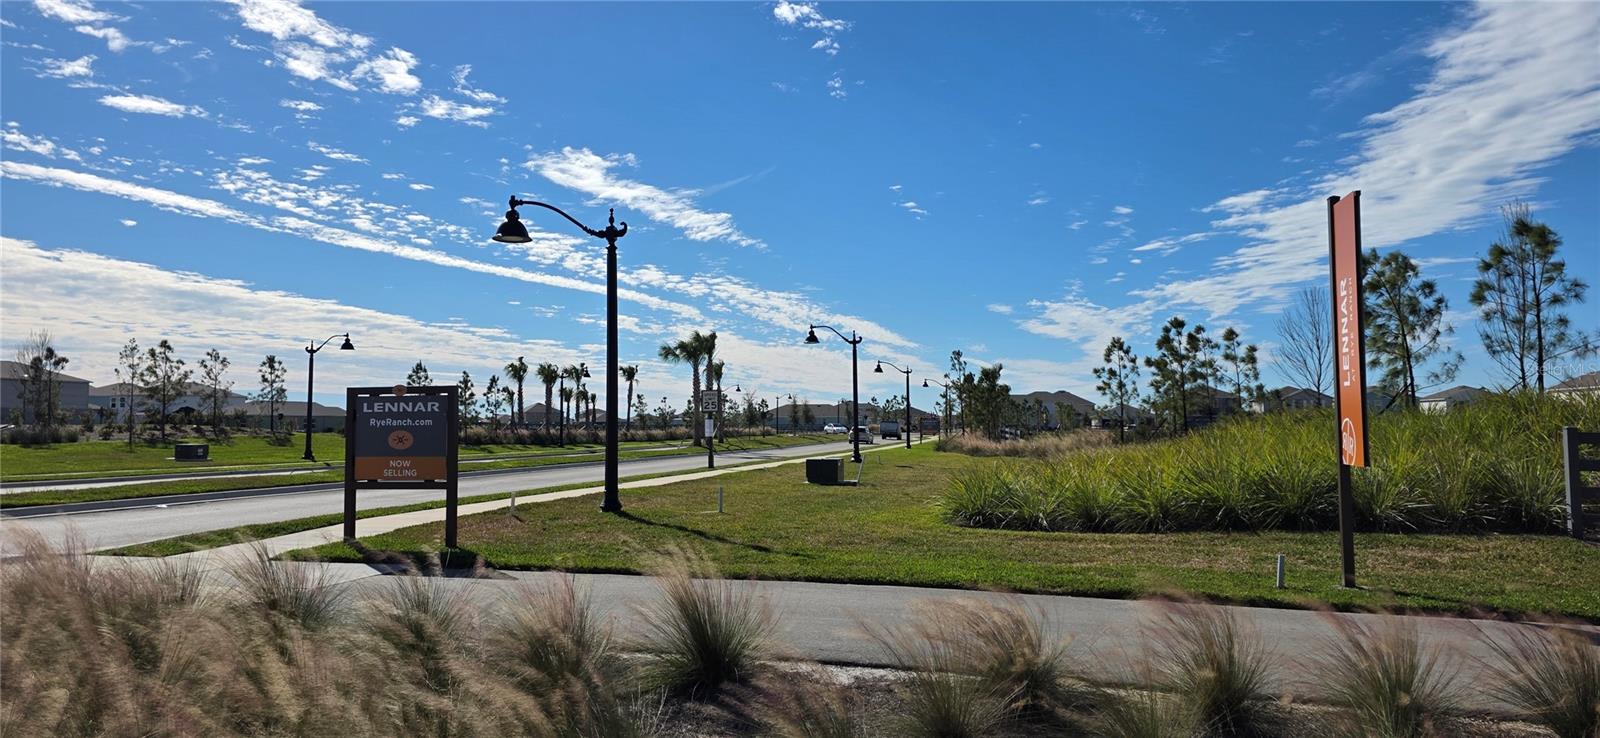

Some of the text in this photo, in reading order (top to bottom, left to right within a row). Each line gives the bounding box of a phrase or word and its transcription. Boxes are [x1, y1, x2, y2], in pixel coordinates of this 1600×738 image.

[1340, 278, 1350, 386] LENNAR
[363, 402, 440, 412] LENNAR
[704, 401, 717, 409] 25
[369, 418, 433, 427] RyeRanch.com
[383, 469, 417, 477] SELLING
